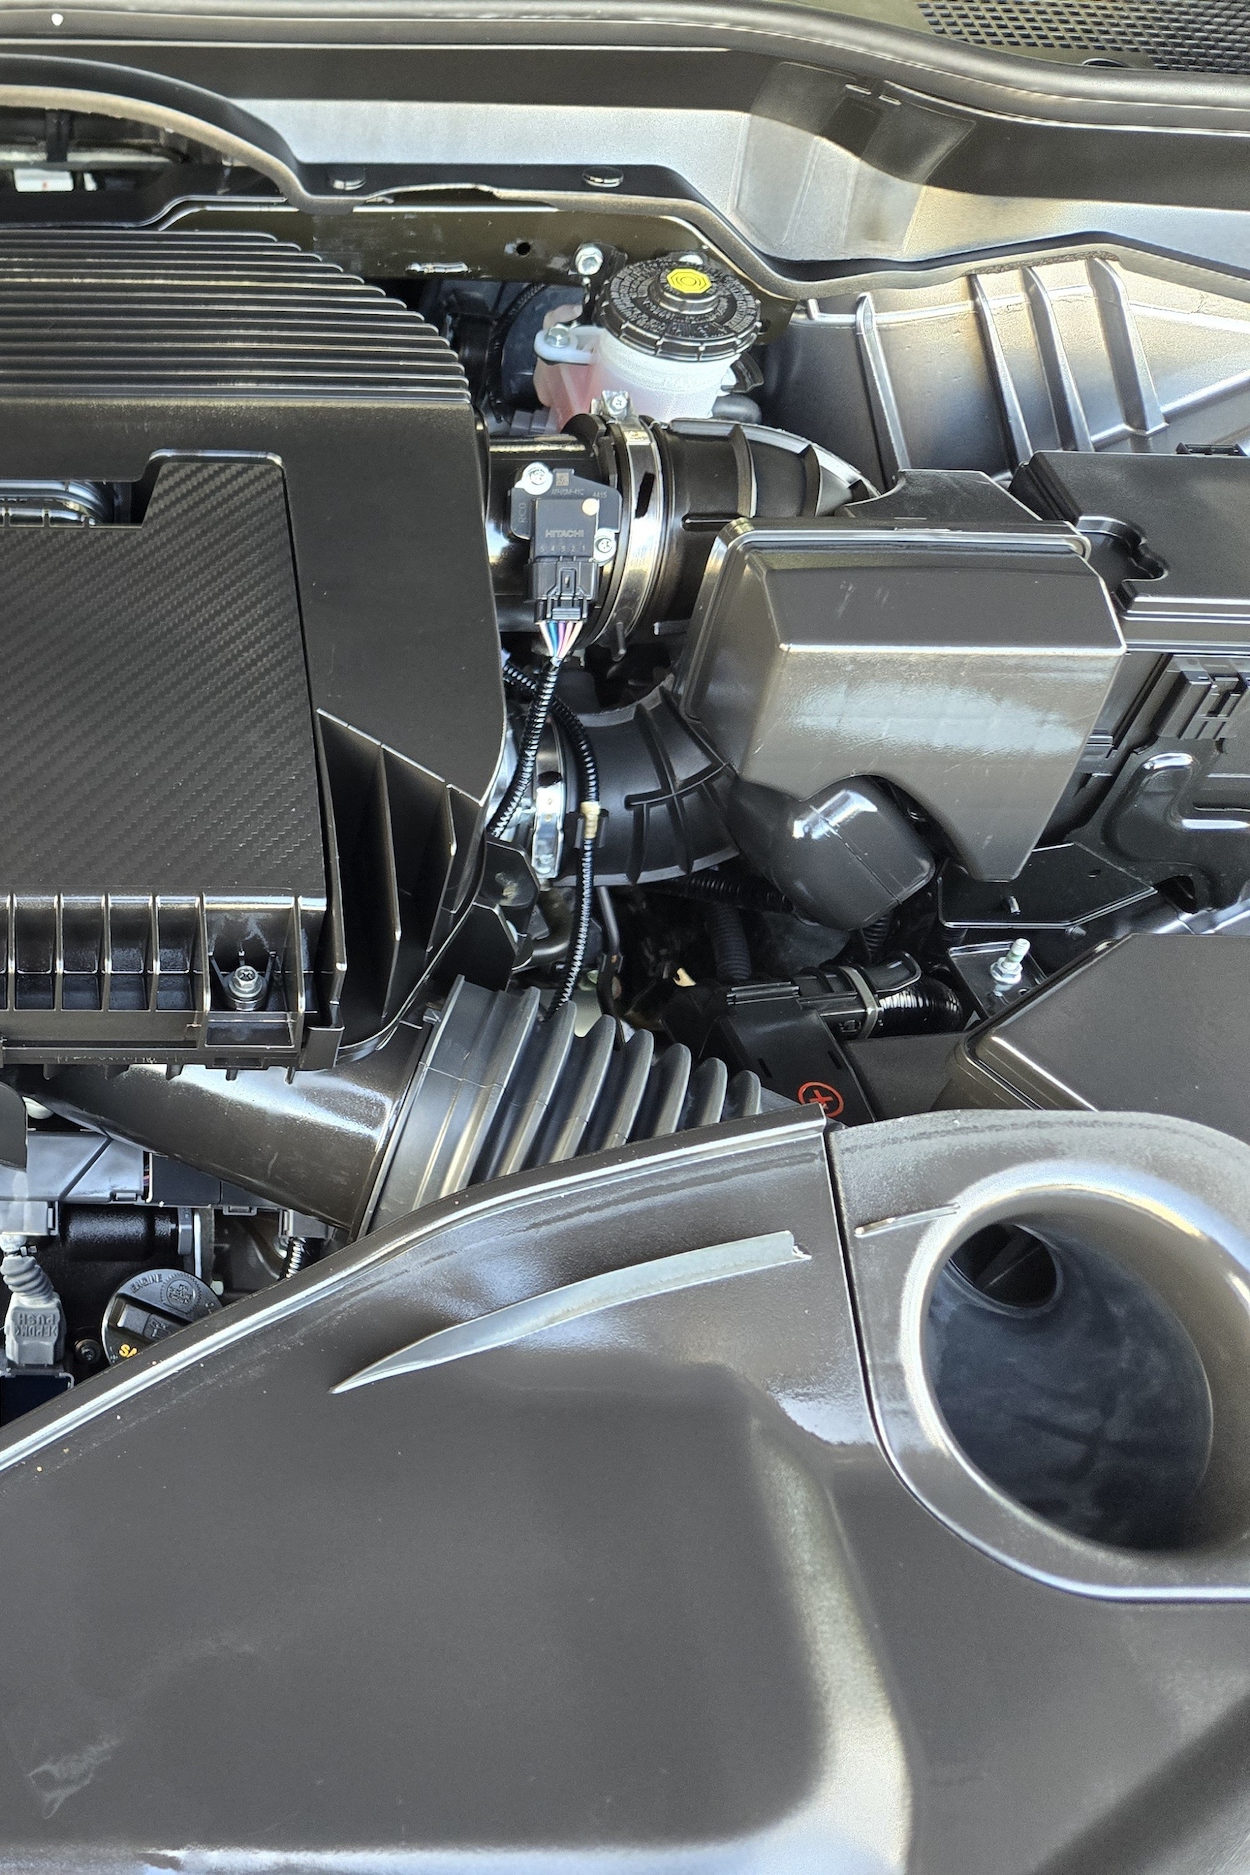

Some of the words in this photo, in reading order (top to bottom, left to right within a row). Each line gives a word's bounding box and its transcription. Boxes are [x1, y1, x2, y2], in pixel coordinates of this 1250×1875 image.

[544, 529, 585, 538] HITACHI
[130, 1273, 163, 1294] ENGINE
[16, 1312, 56, 1325] PUSH
